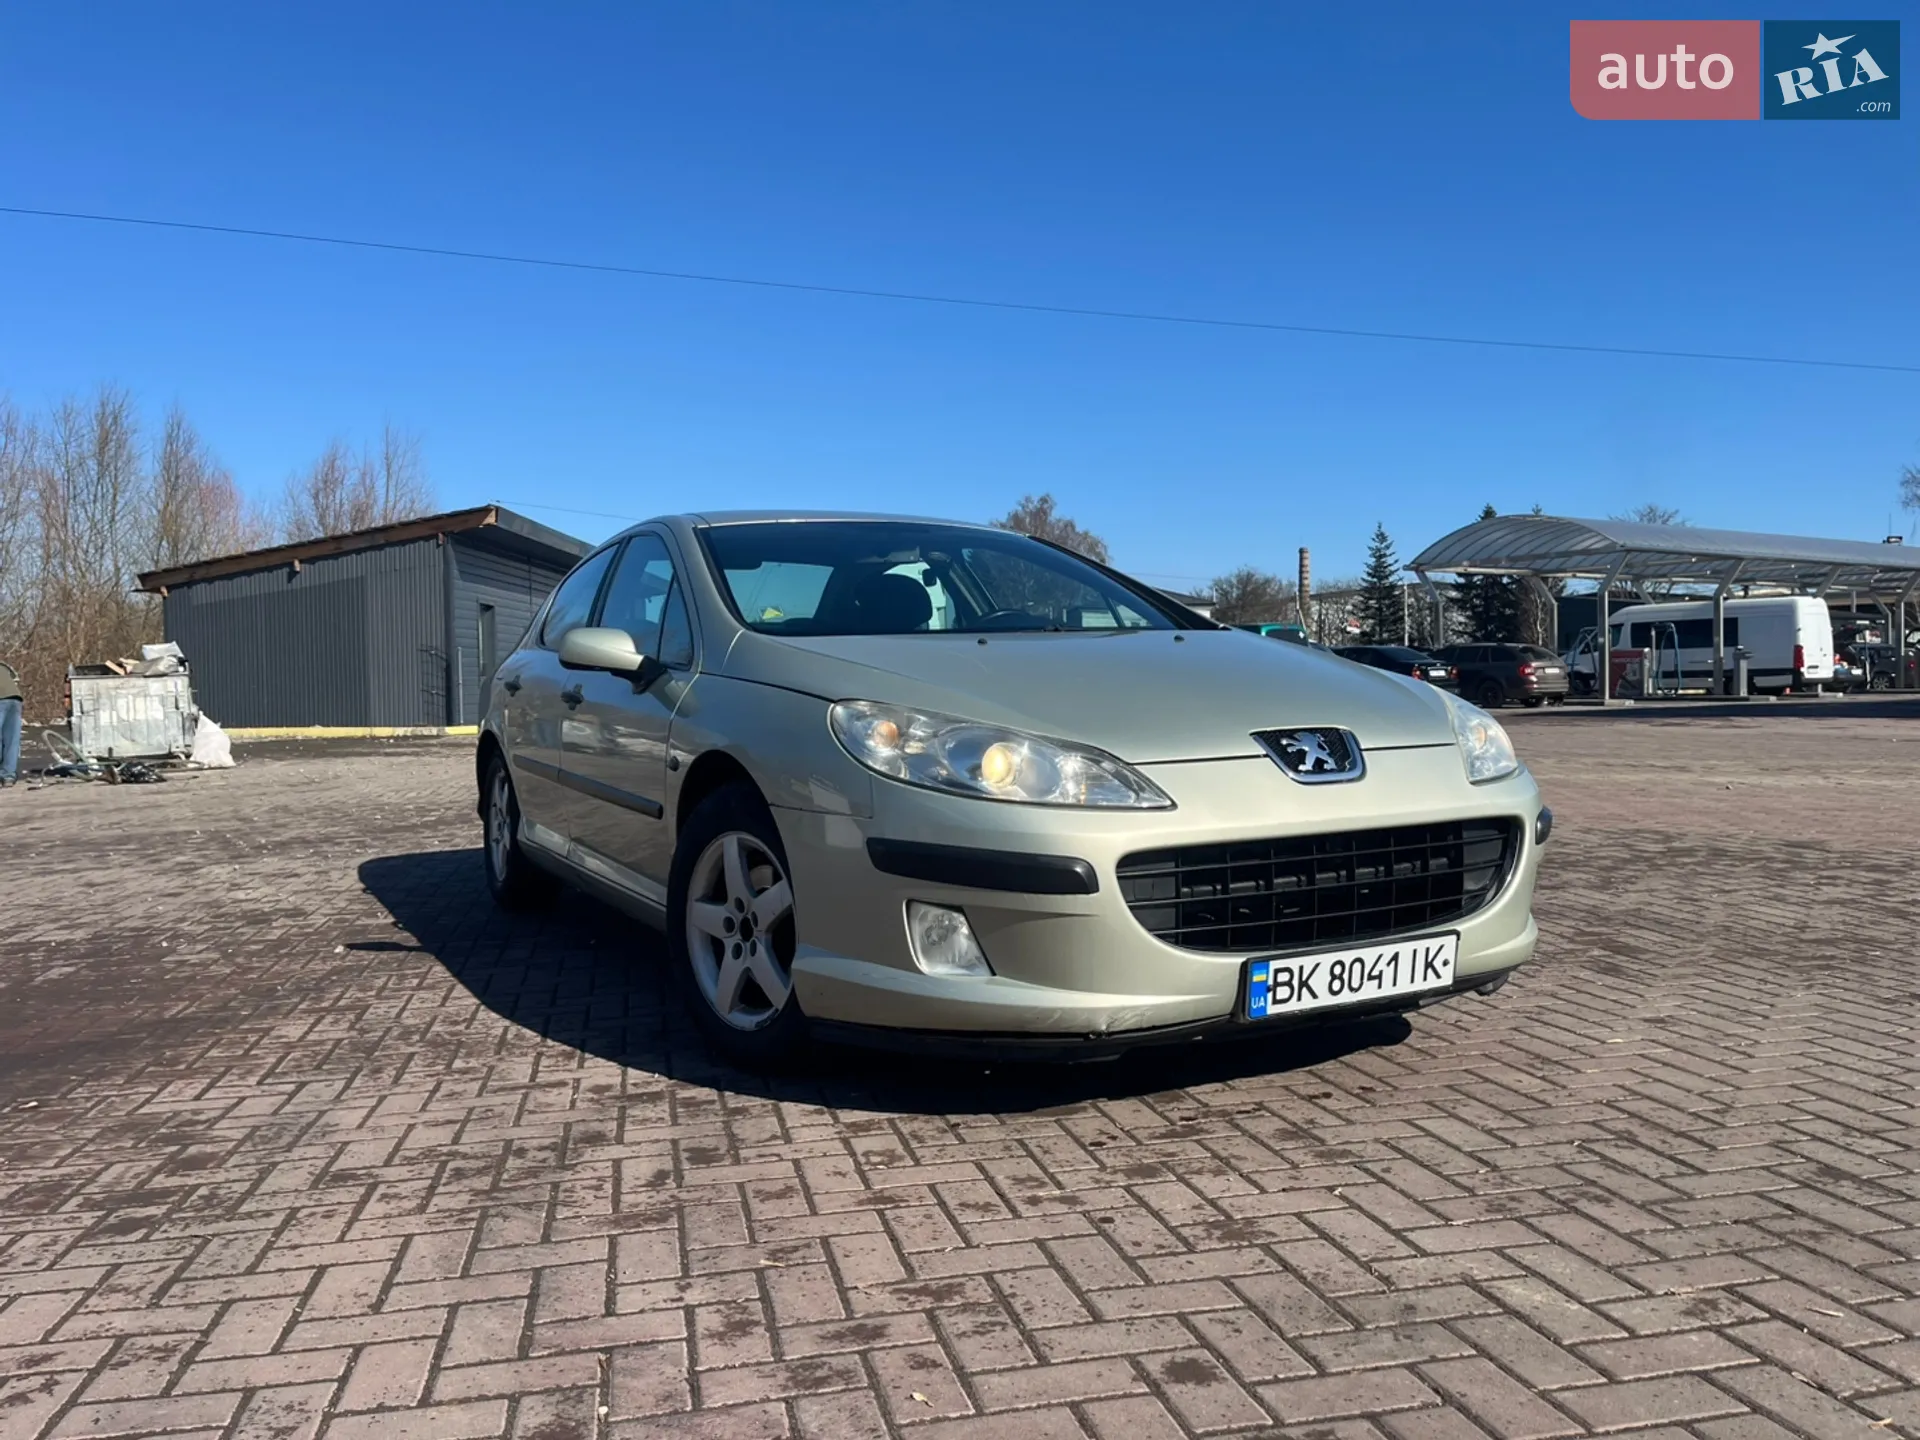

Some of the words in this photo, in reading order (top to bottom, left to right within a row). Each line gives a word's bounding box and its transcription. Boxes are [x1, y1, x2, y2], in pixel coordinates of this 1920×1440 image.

[1271, 961, 1321, 1006] BK
[1327, 951, 1400, 997] 8041
[1410, 944, 1445, 984] IK
[1251, 997, 1266, 1009] UA
